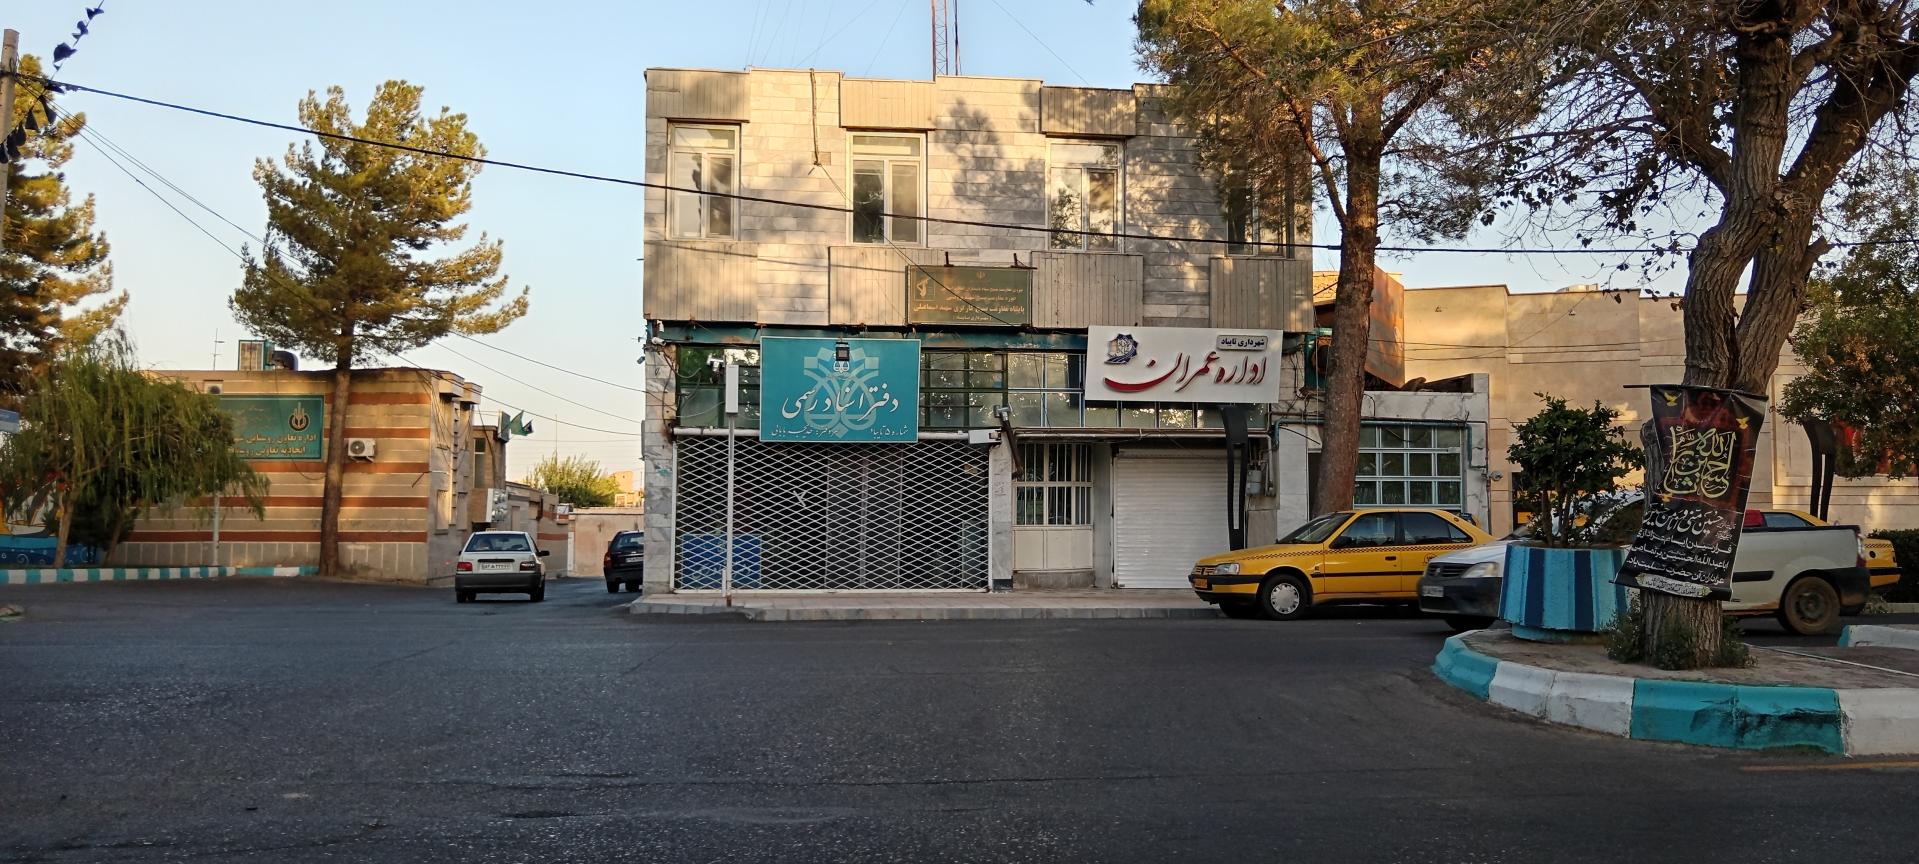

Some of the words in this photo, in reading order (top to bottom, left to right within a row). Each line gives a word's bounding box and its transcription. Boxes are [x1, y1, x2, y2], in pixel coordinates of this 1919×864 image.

[1220, 337, 1237, 347] تایباد
[1237, 338, 1265, 348] شهرداری
[1103, 351, 1220, 393] عمران
[1214, 354, 1267, 385] اداره
[781, 388, 818, 419] رسمی
[822, 387, 864, 412] اسناد
[856, 382, 899, 422] دفتر
[298, 433, 317, 444] اداره
